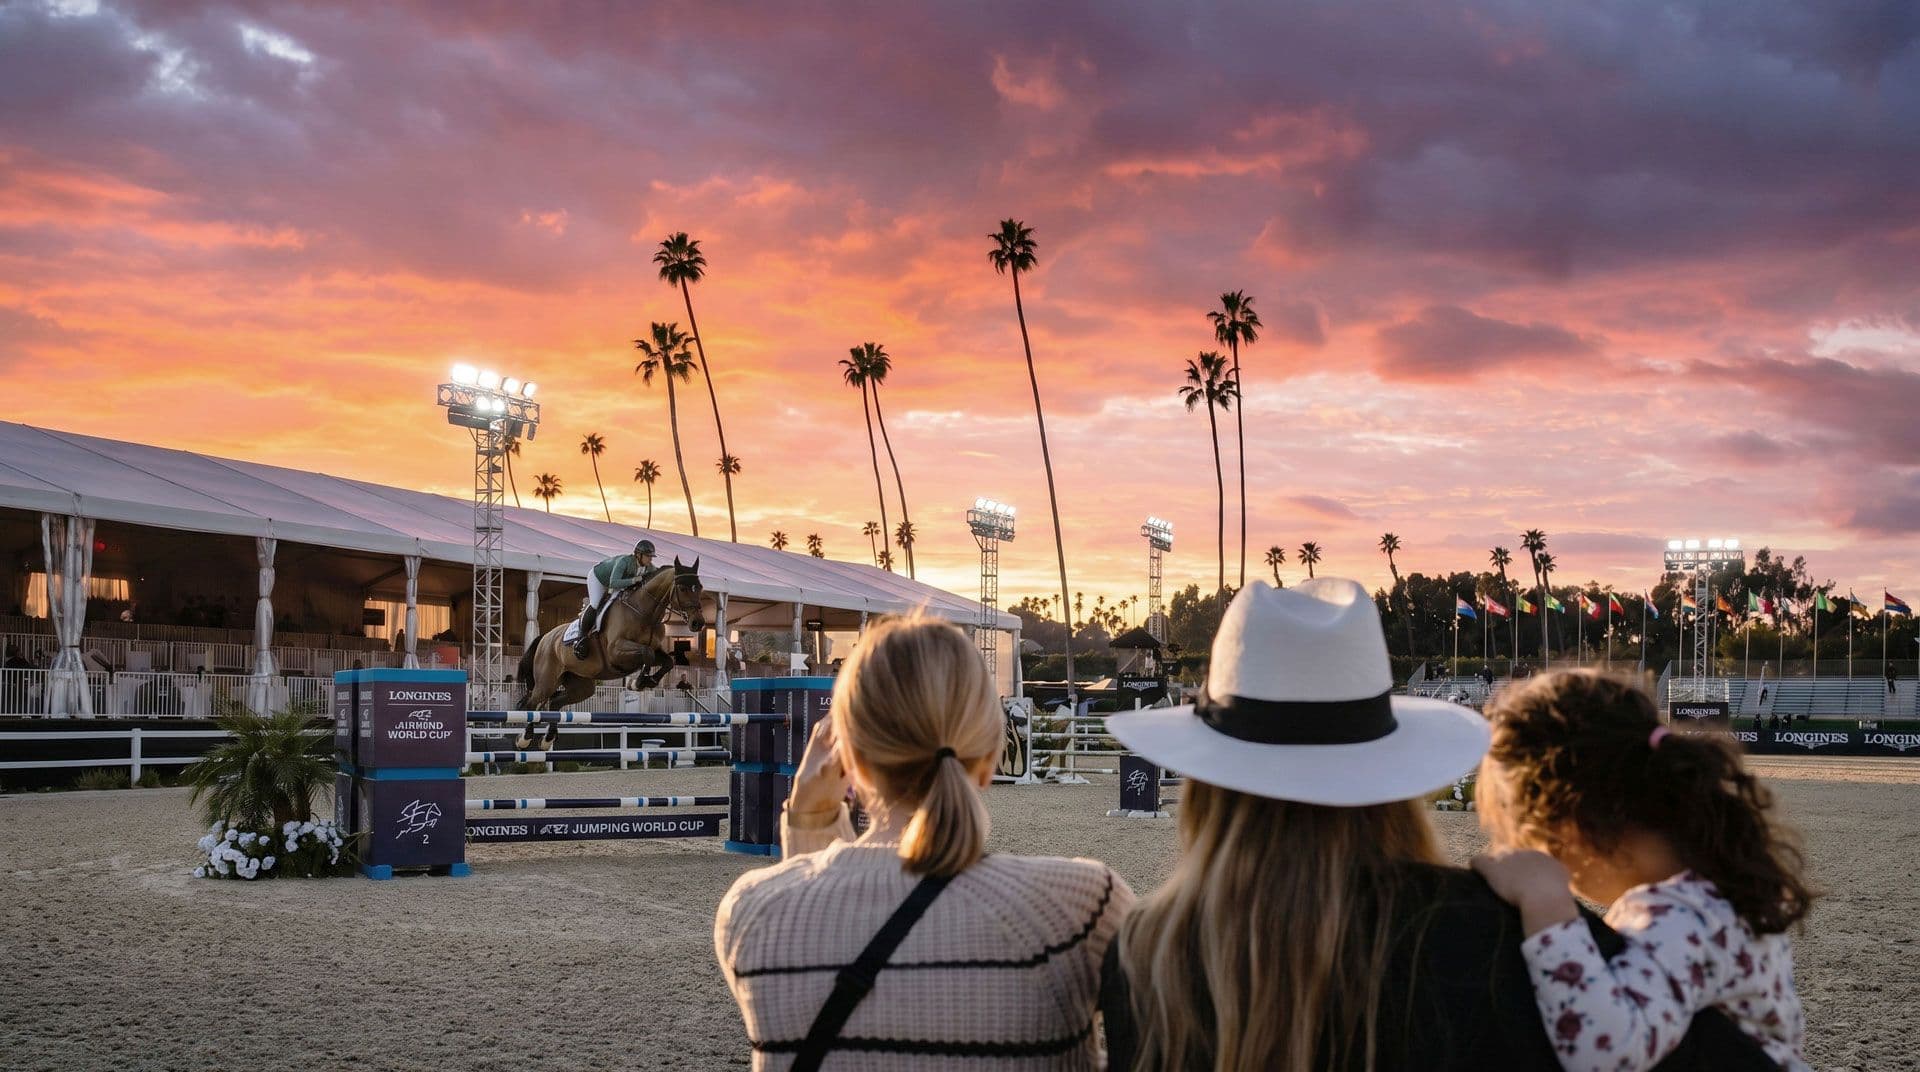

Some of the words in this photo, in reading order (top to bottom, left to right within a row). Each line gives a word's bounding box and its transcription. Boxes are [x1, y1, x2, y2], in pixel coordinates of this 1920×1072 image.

[388, 690, 452, 701] LONGINES
[387, 730, 427, 739] WORLD
[428, 730, 451, 739] CUP
[1774, 732, 1849, 743] LONGINES
[572, 822, 630, 834] JUMPING
[632, 821, 677, 833] WORLD
[679, 820, 705, 831] CUP
[422, 834, 430, 845] 2
